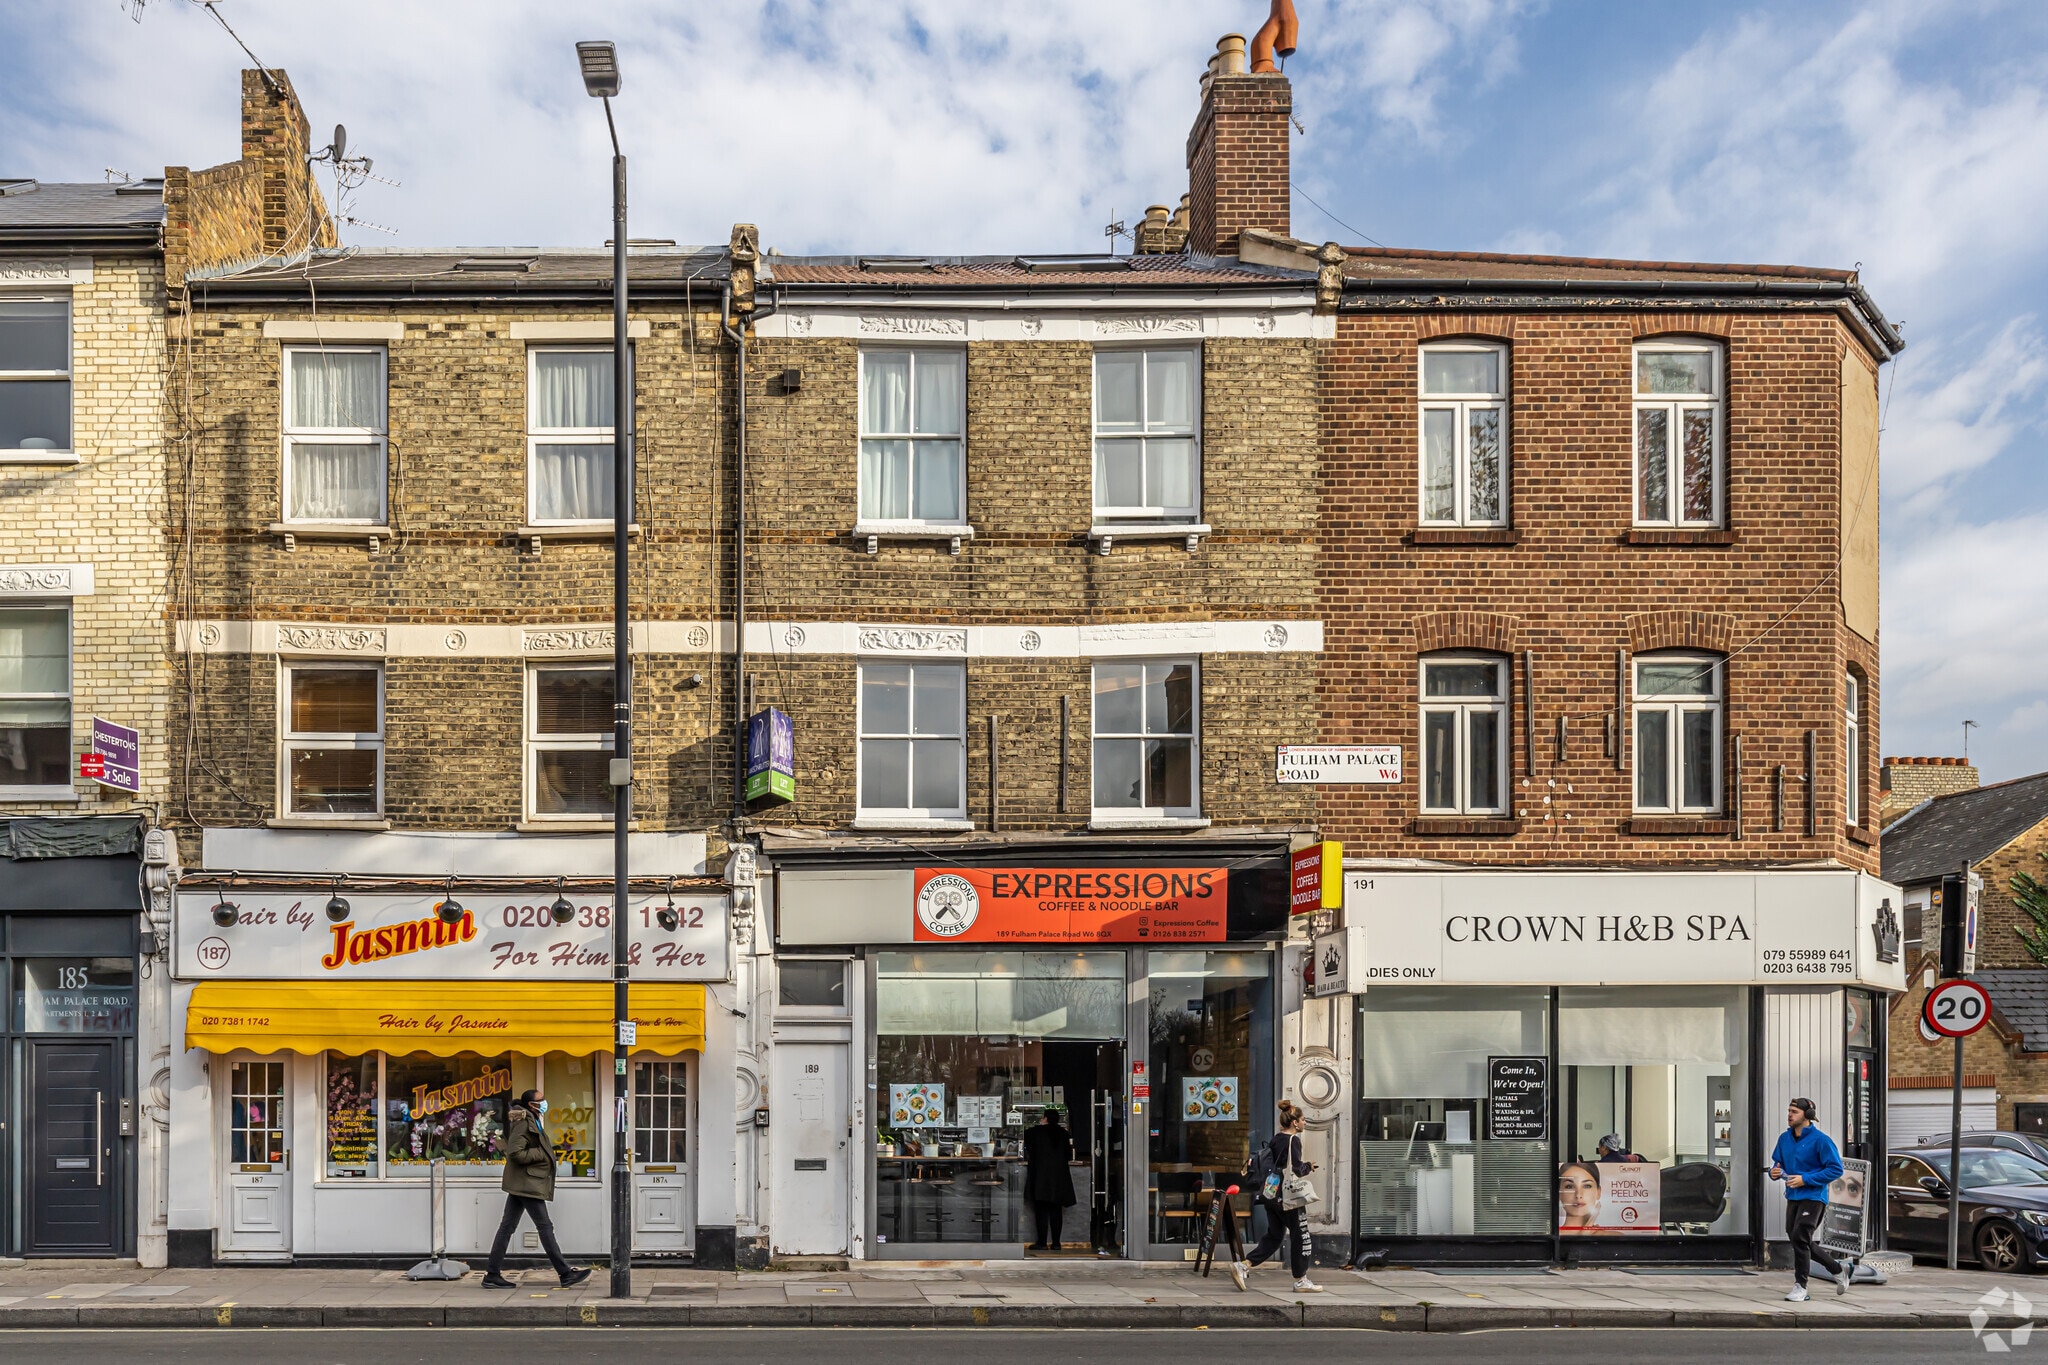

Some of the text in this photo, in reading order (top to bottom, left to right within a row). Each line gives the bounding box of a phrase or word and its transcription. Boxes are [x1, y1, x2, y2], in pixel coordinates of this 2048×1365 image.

[95, 731, 136, 751] CHESTERTONS
[1282, 754, 1398, 765] FULHAM PALACE
[112, 769, 131, 785] Sale
[1379, 769, 1398, 779] W6
[1294, 855, 1320, 871] EXPRESSIONS
[992, 873, 1213, 898] EXPRESSIONS
[1296, 873, 1318, 888] COFFEE &
[1353, 880, 1375, 889] 191
[922, 877, 976, 902] EXPRESSIONS
[1292, 888, 1321, 905] NOODLE BAR
[1038, 901, 1179, 911] COFFEE & NOODLE BAR
[211, 902, 314, 932] air by
[503, 906, 566, 928] 020
[640, 906, 704, 928] 142
[929, 921, 967, 934] COFFEE
[1153, 920, 1194, 928] Expressions
[1445, 914, 1751, 942] CROWN H&B SPA
[202, 948, 227, 960] 187
[490, 941, 707, 970] For Him & Her
[1763, 950, 1850, 960] 079 55989 641
[1366, 967, 1436, 978] DIES ONLY
[1763, 963, 1852, 973] 0203 6438 795
[58, 967, 88, 989] 185
[64, 997, 98, 1005] PALACE
[103, 997, 128, 1005] ROAD
[1937, 996, 1982, 1020] 20
[202, 1016, 270, 1026] 020 7381 1742
[378, 1014, 509, 1034] Hair by Jasmin
[653, 1018, 661, 1026] &
[664, 1017, 682, 1026] Her
[805, 1064, 820, 1073] 189
[1500, 1065, 1537, 1076] Come In,
[1493, 1080, 1544, 1091] We're Open!
[410, 1065, 512, 1120] Jasmin
[549, 1107, 594, 1124] 0207
[552, 1128, 586, 1145] 381
[390, 1159, 405, 1167] 187,
[408, 1158, 430, 1166] Fulha
[444, 1158, 467, 1166] alace
[470, 1157, 483, 1167] Rd,
[1611, 1181, 1643, 1189] HYDRA
[1611, 1189, 1649, 1198] PEELING
